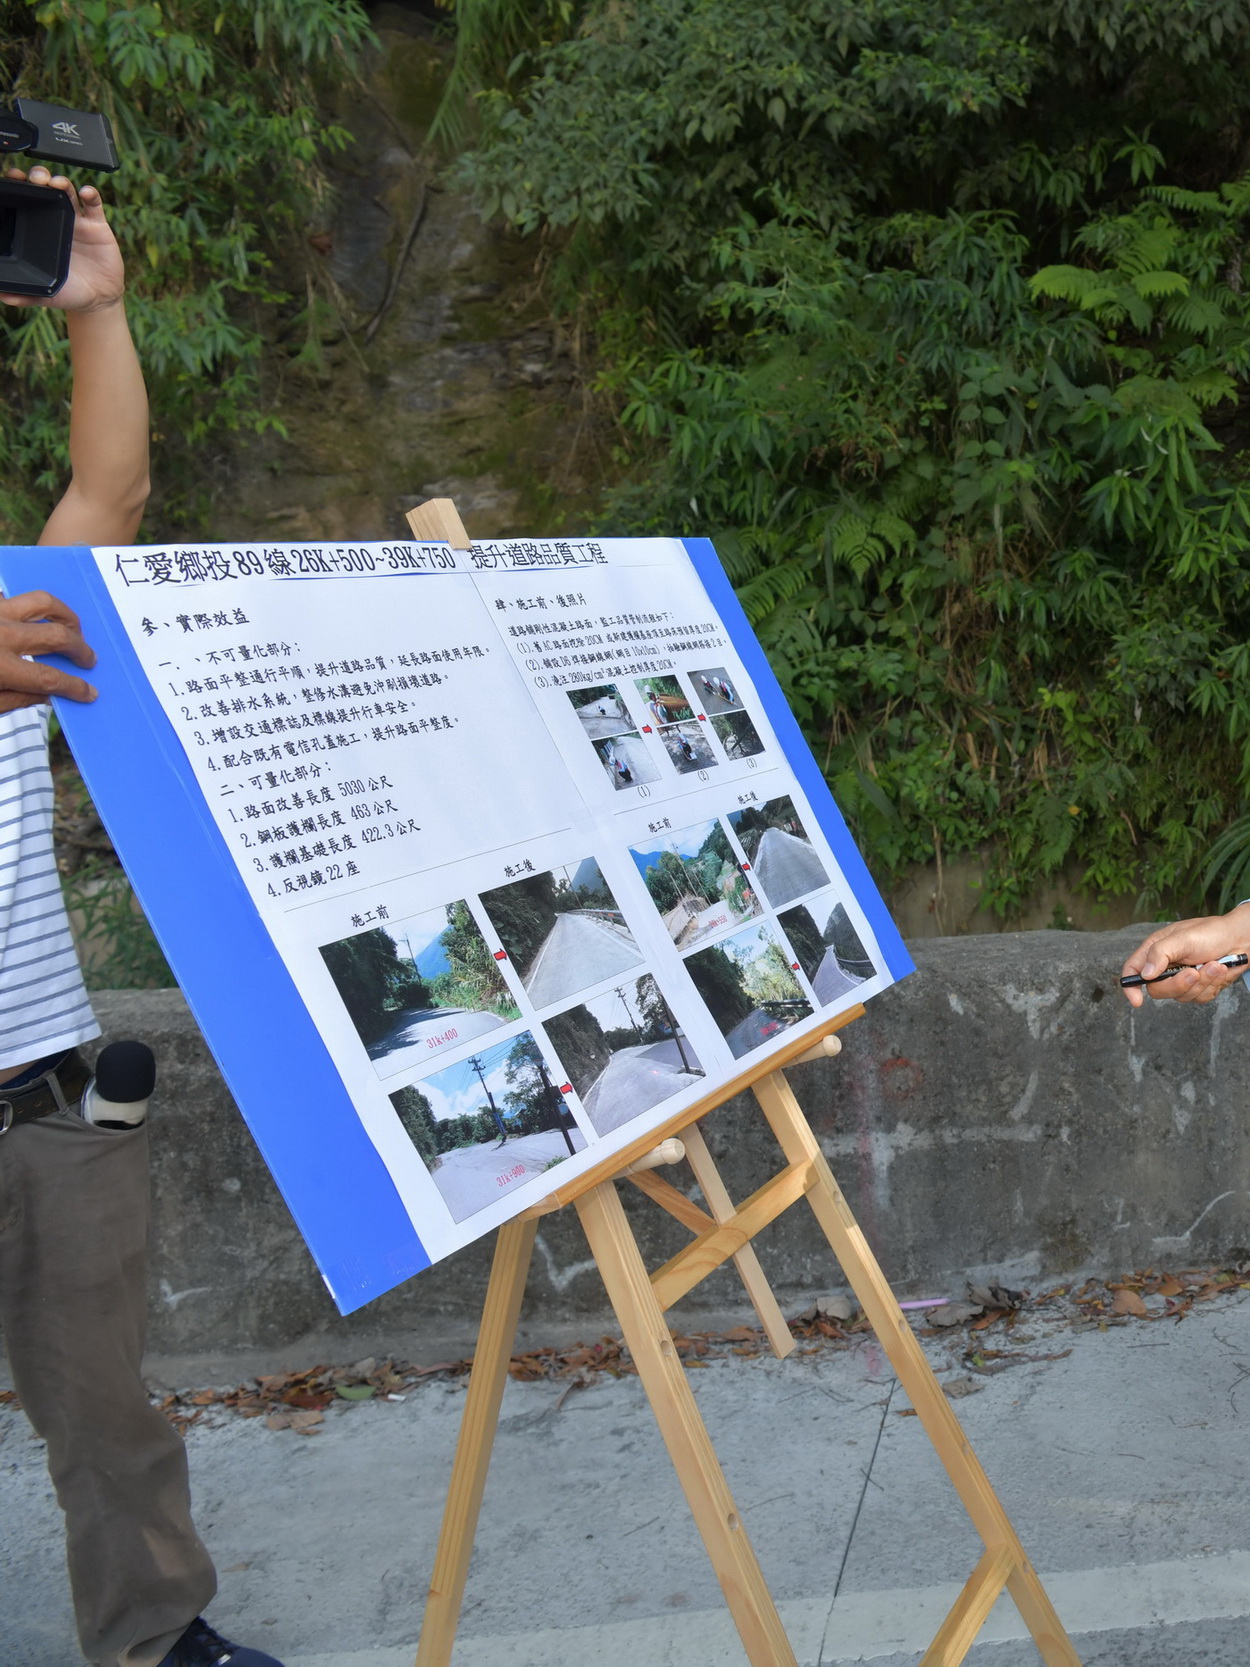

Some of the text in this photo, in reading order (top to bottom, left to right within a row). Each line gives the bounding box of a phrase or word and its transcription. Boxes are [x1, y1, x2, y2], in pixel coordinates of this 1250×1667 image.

[51, 121, 80, 136] 4K
[468, 542, 609, 569] 提升道路品質工程
[746, 757, 758, 769] (3)
[697, 769, 710, 782] (2)
[637, 785, 651, 798] (1)
[647, 816, 672, 833] 施工前
[503, 858, 536, 878] 施工後
[350, 904, 390, 928] 施工前
